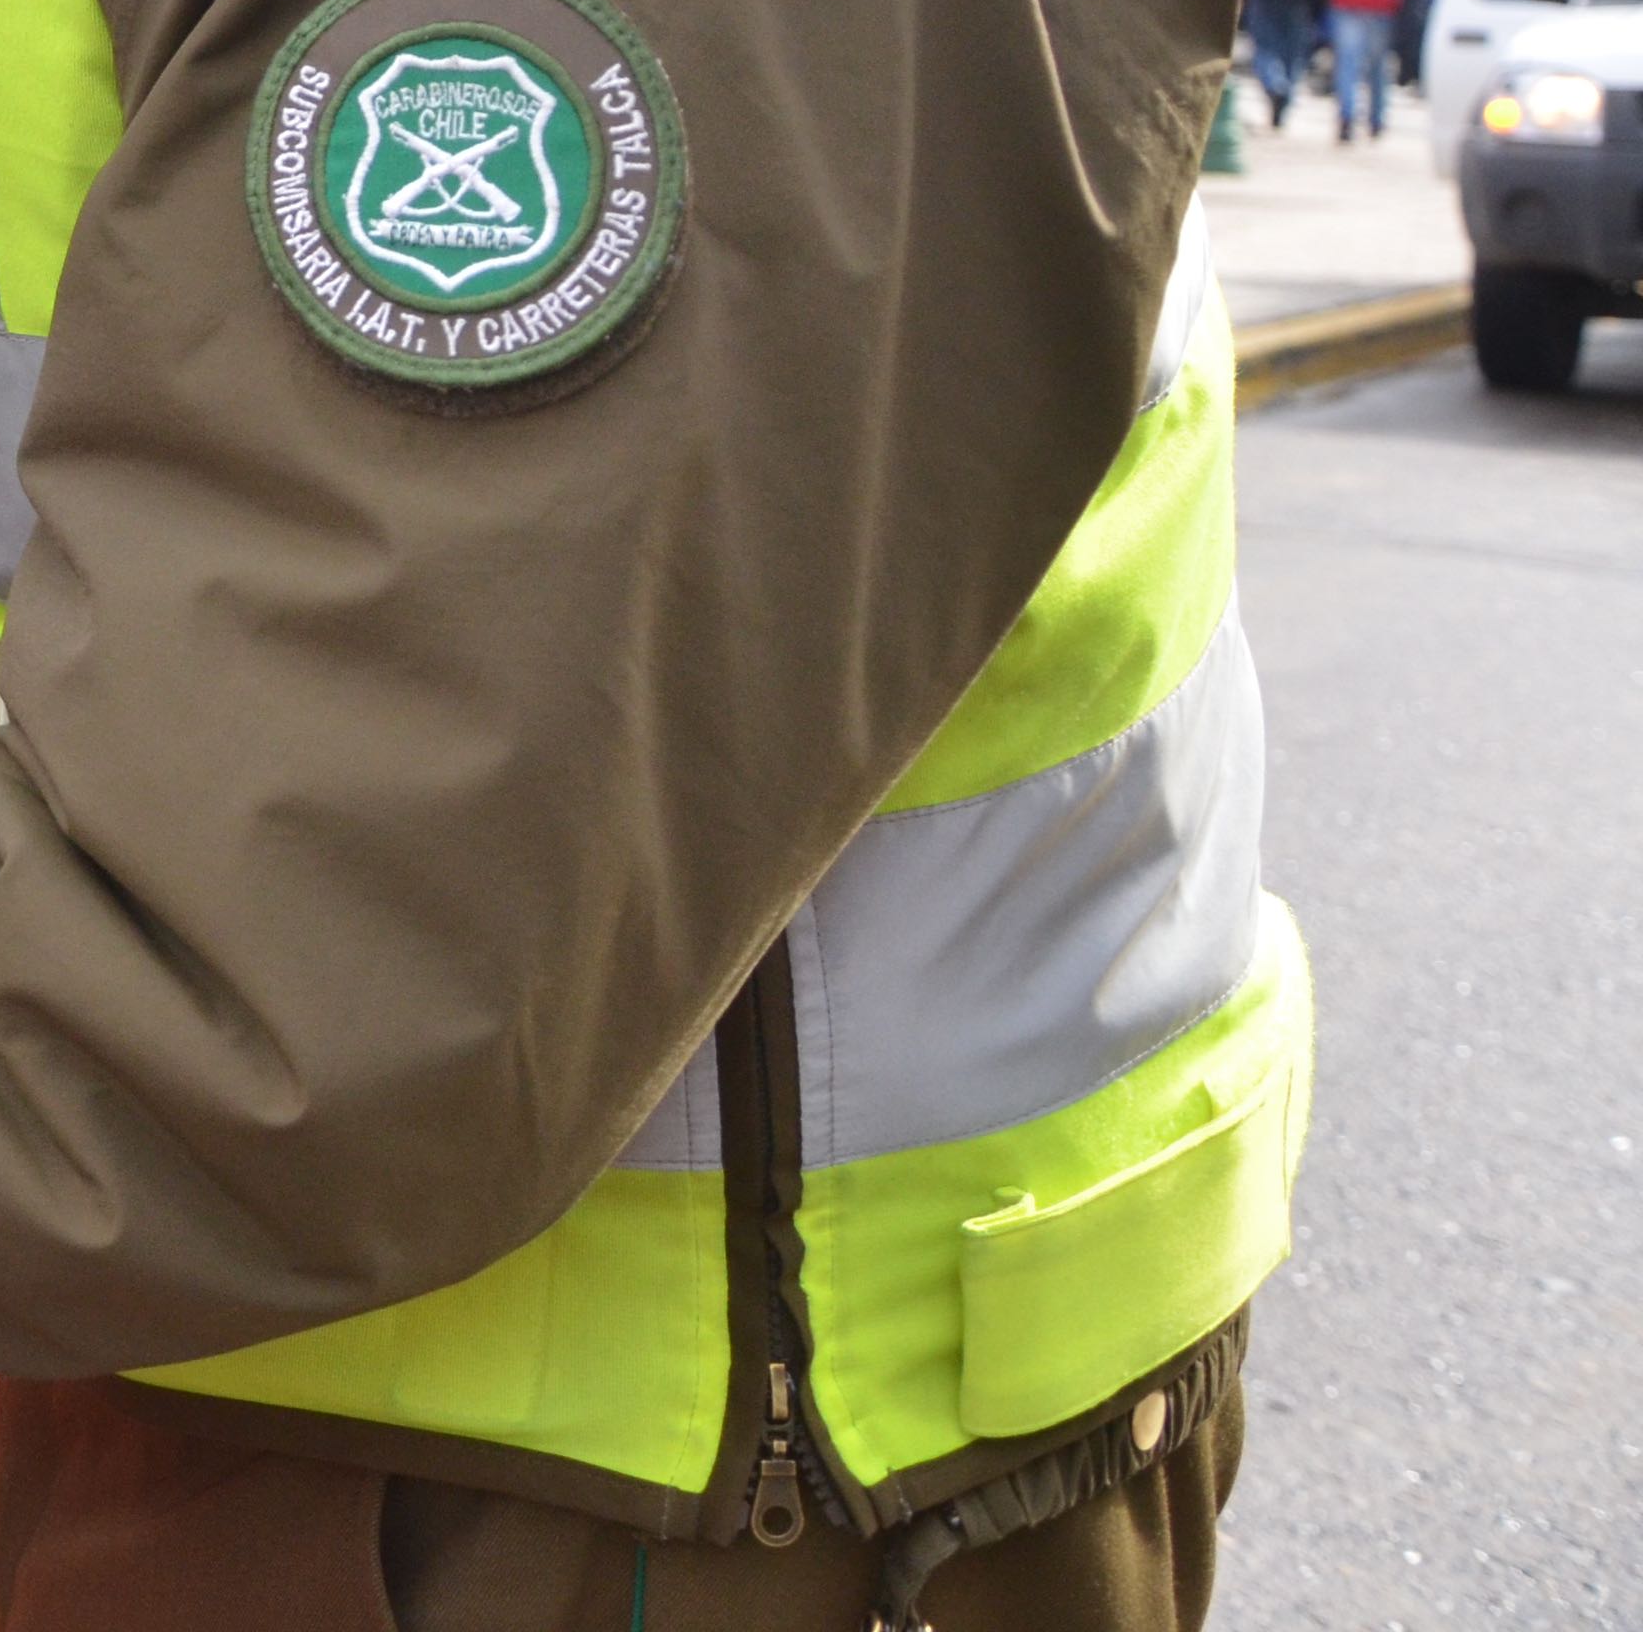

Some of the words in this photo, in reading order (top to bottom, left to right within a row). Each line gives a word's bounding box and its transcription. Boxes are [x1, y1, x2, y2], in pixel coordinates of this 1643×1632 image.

[418, 108, 489, 140] CHILE
[273, 65, 350, 310] SUBCOMISARIA
[441, 319, 466, 357] Y
[478, 189, 646, 353] CARRETERAS
[590, 62, 653, 174] TALCA
